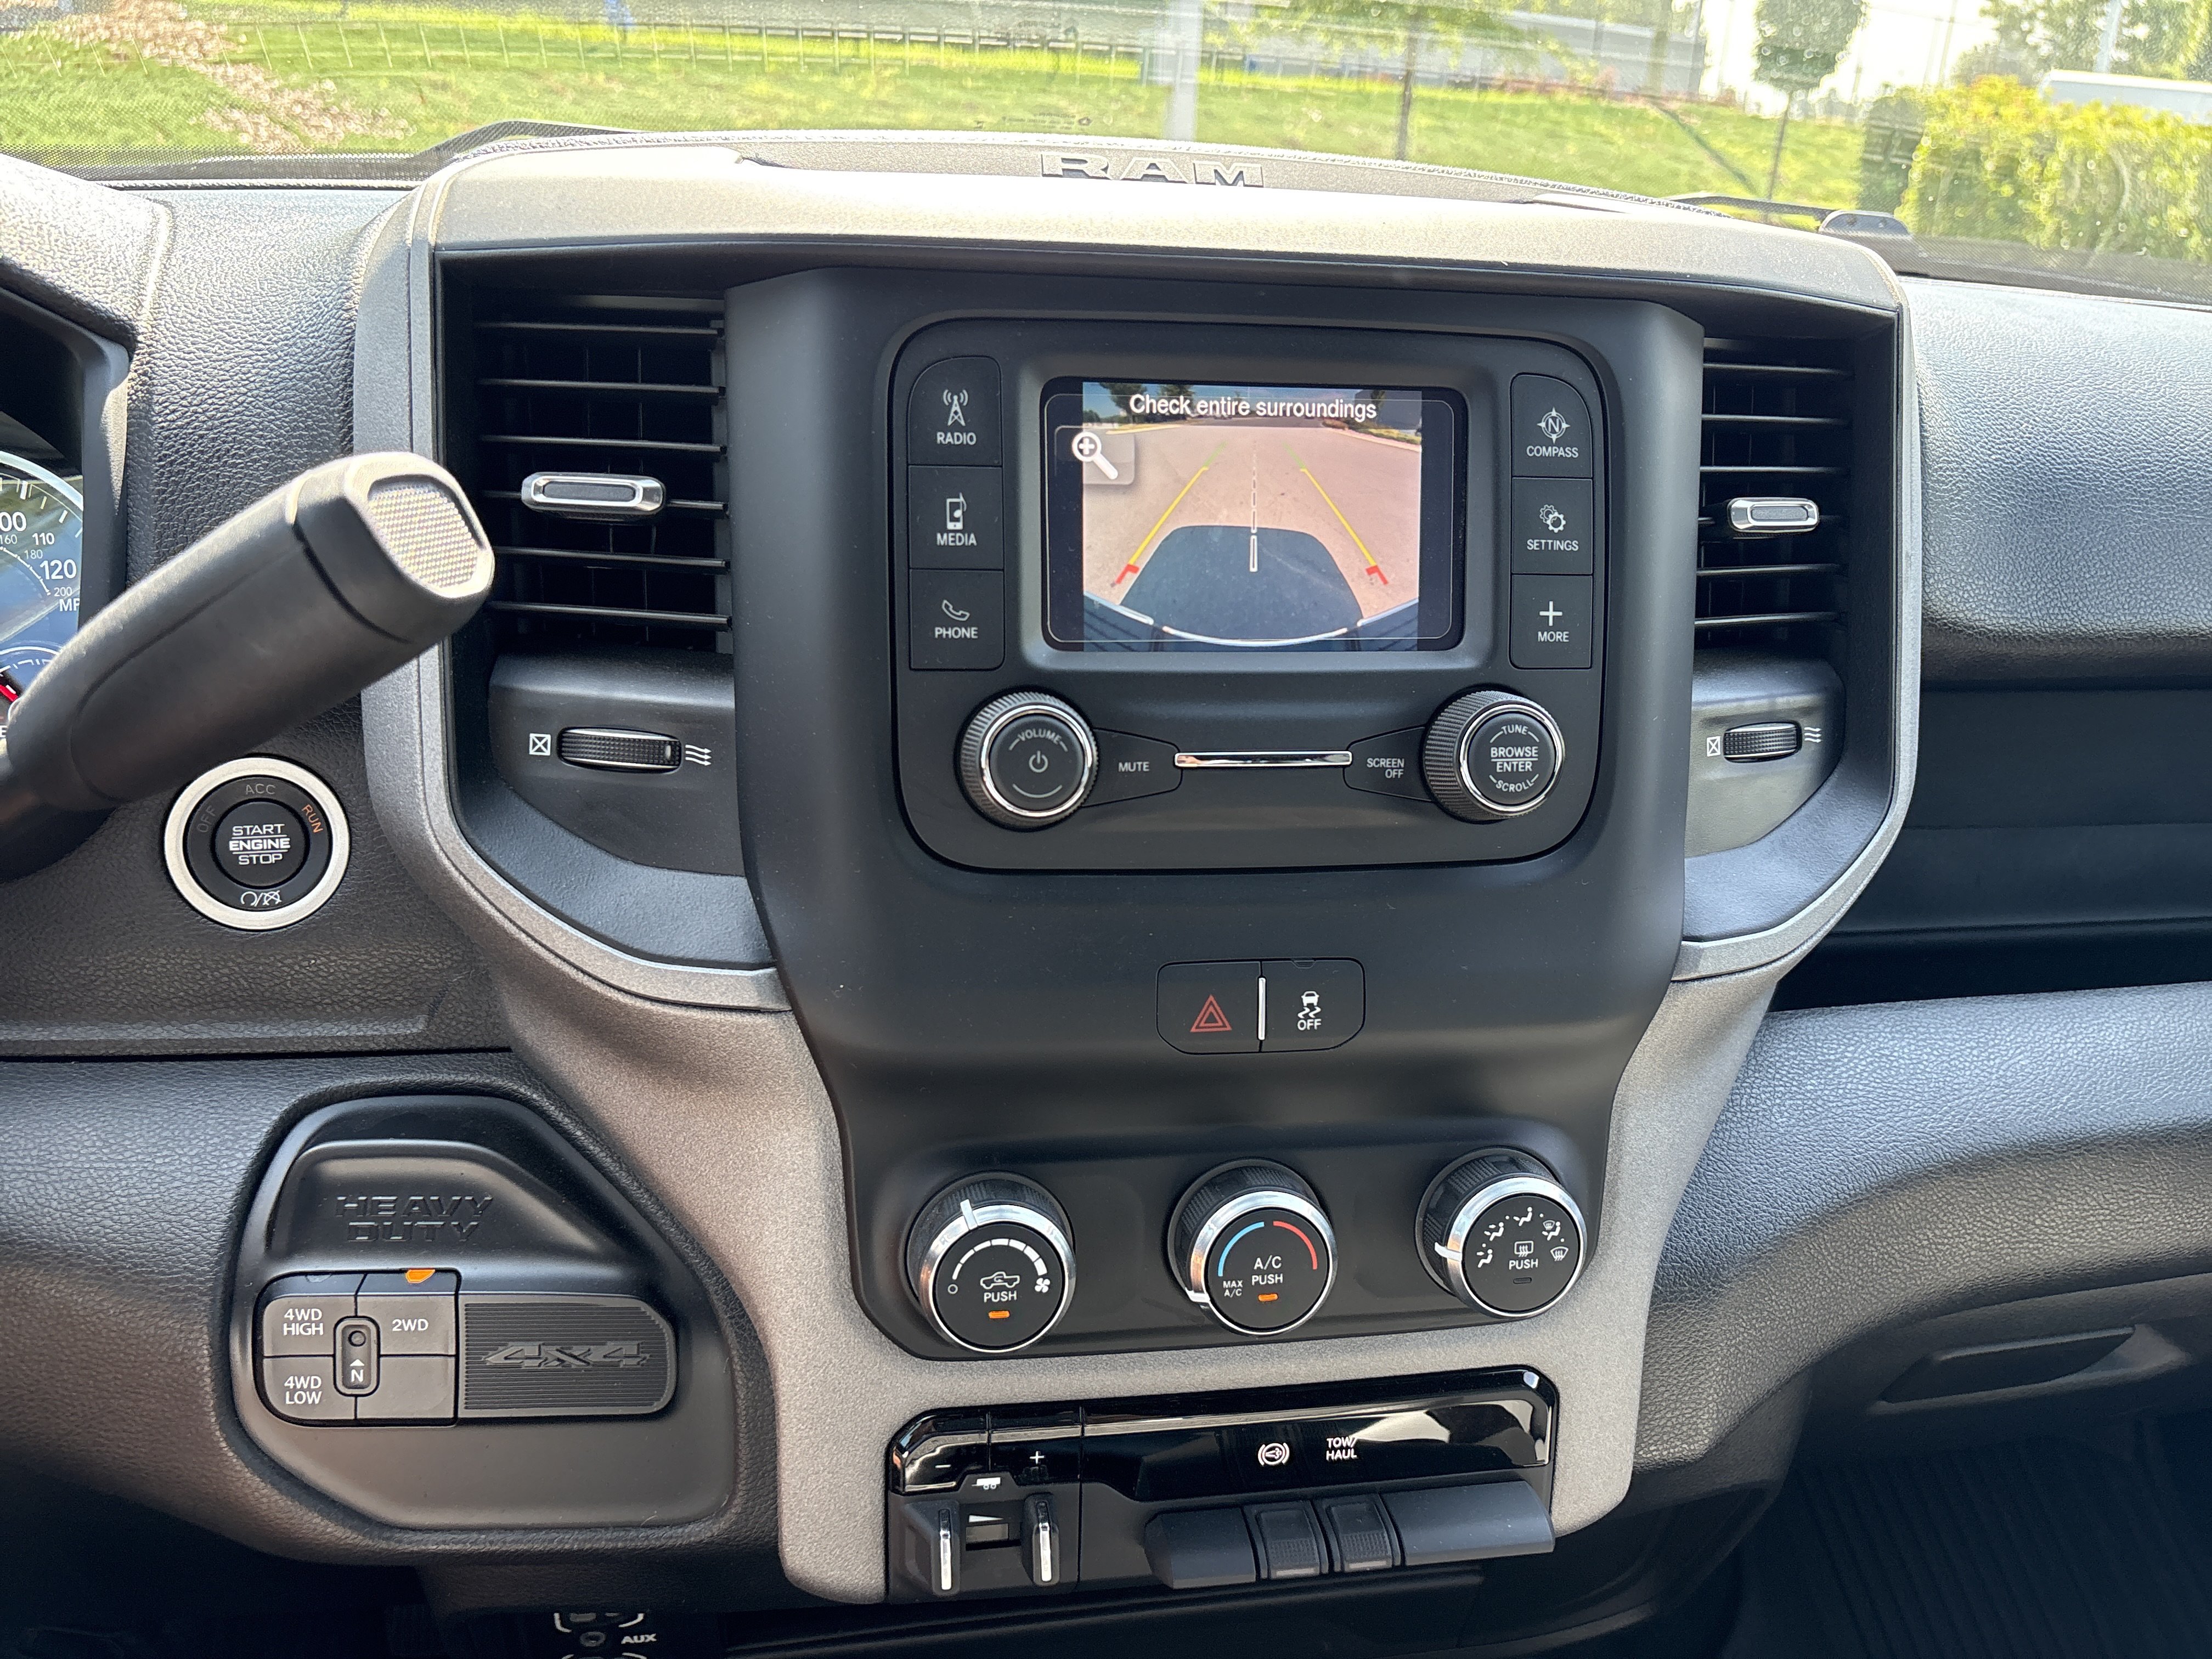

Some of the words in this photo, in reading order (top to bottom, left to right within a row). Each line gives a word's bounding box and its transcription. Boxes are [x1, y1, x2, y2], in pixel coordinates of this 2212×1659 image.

[1041, 151, 1265, 188] RAM
[1129, 394, 1191, 415] Check
[1197, 397, 1250, 416] entire
[1256, 399, 1377, 423] surroundings
[936, 431, 977, 446] RADIO
[1526, 445, 1579, 459] COMPASS
[0, 511, 27, 532] 00
[32, 532, 55, 545] 110
[936, 532, 977, 546] MEDIA
[1526, 539, 1579, 552] SETTINGS
[24, 549, 43, 560] 180
[40, 558, 77, 580] 120
[54, 586, 72, 597] 200
[59, 598, 80, 612] MP
[934, 626, 978, 640] PHONE
[1537, 631, 1570, 643] MORE
[1018, 729, 1062, 744] VOLUME
[1500, 725, 1529, 736] TUNE
[1491, 746, 1539, 758] BROWSE
[1118, 761, 1150, 772] MUTE
[1366, 758, 1405, 769] SCREEN
[1496, 761, 1533, 772] ENTER
[1385, 769, 1404, 779] OFF
[246, 783, 275, 795] ACC
[1496, 780, 1535, 793] SCROLL
[303, 804, 324, 833] RUN
[232, 823, 285, 836] START
[229, 838, 291, 851] ENGINE
[238, 853, 283, 865] STOP
[1297, 1019, 1322, 1030] OFF
[335, 1195, 493, 1217] HEAVY
[347, 1221, 479, 1242] DUTY
[1254, 1255, 1282, 1271] A/C
[1509, 1259, 1538, 1270] PUSH
[1223, 1280, 1243, 1288] MAX
[1251, 1273, 1283, 1286] PUSH
[984, 1290, 1017, 1302] PUSH
[1224, 1288, 1243, 1298] A/C
[284, 1308, 323, 1321] 4WD
[283, 1323, 324, 1335] HIGH
[392, 1319, 429, 1331] 2WD
[351, 1369, 364, 1382] N
[284, 1376, 321, 1389] 4WD
[285, 1391, 322, 1404] LOW
[1326, 1448, 1357, 1460] HAUL
[620, 1633, 657, 1644] AUX
